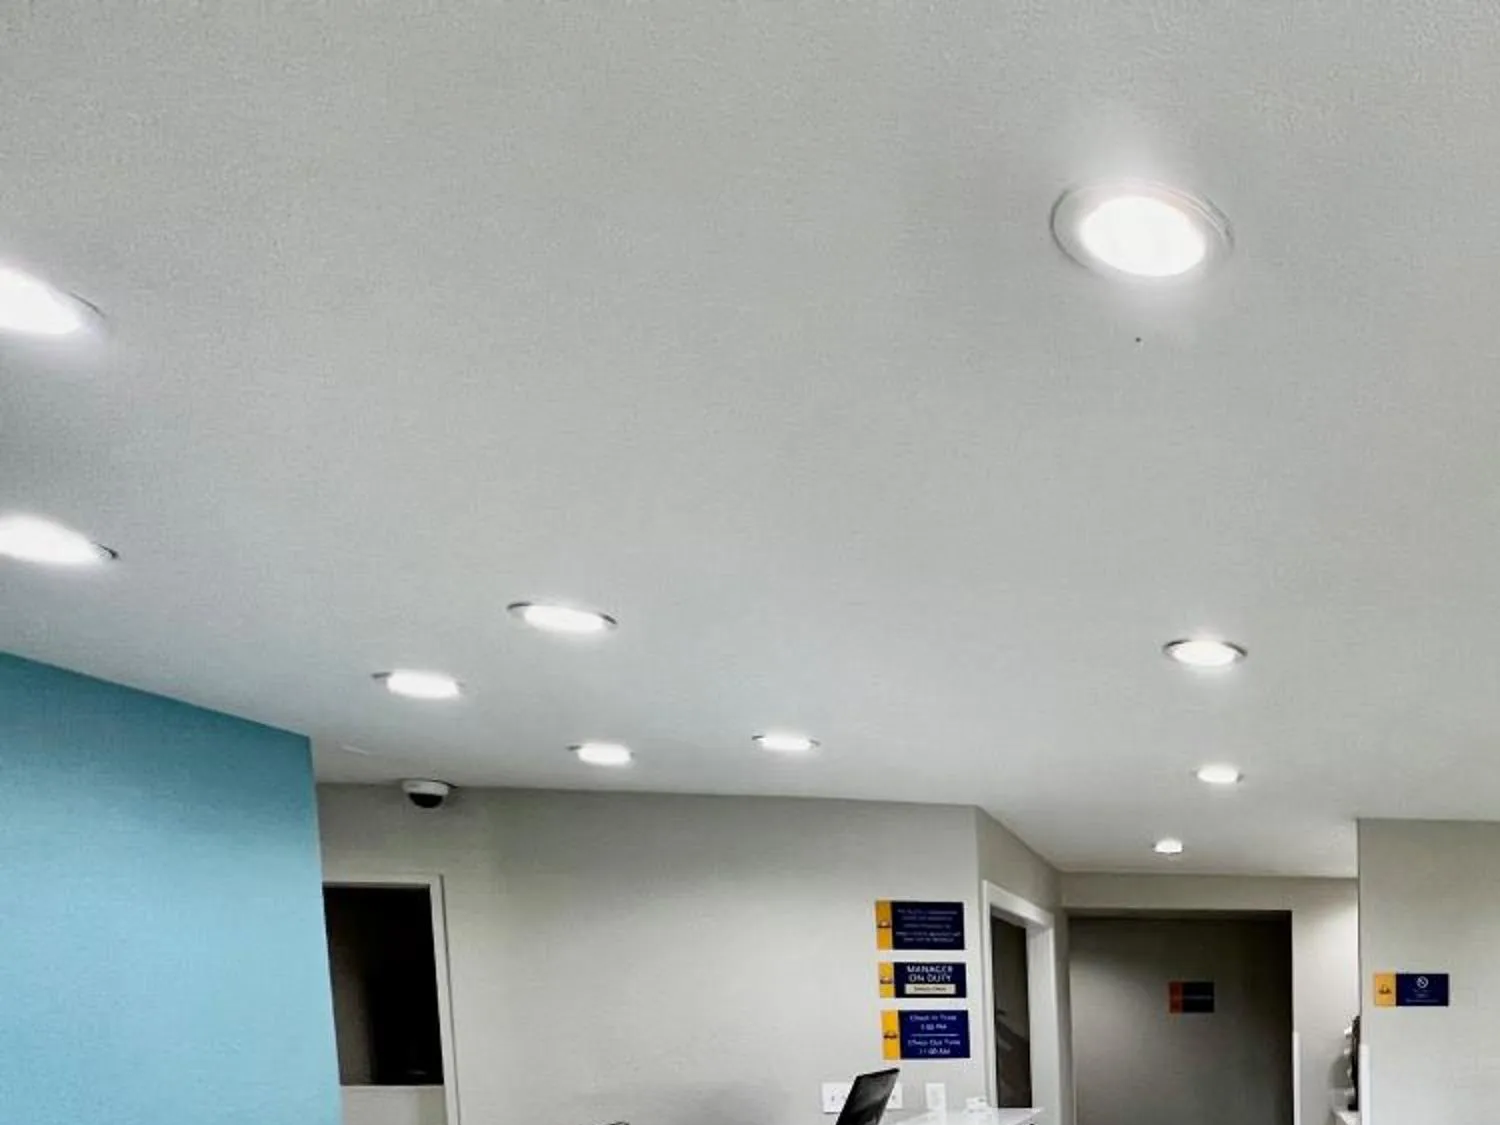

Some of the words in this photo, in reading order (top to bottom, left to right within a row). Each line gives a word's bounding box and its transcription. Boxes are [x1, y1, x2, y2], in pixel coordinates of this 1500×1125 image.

[906, 964, 954, 974] MANAGER
[908, 973, 926, 983] ON
[926, 973, 952, 983] DUTY
